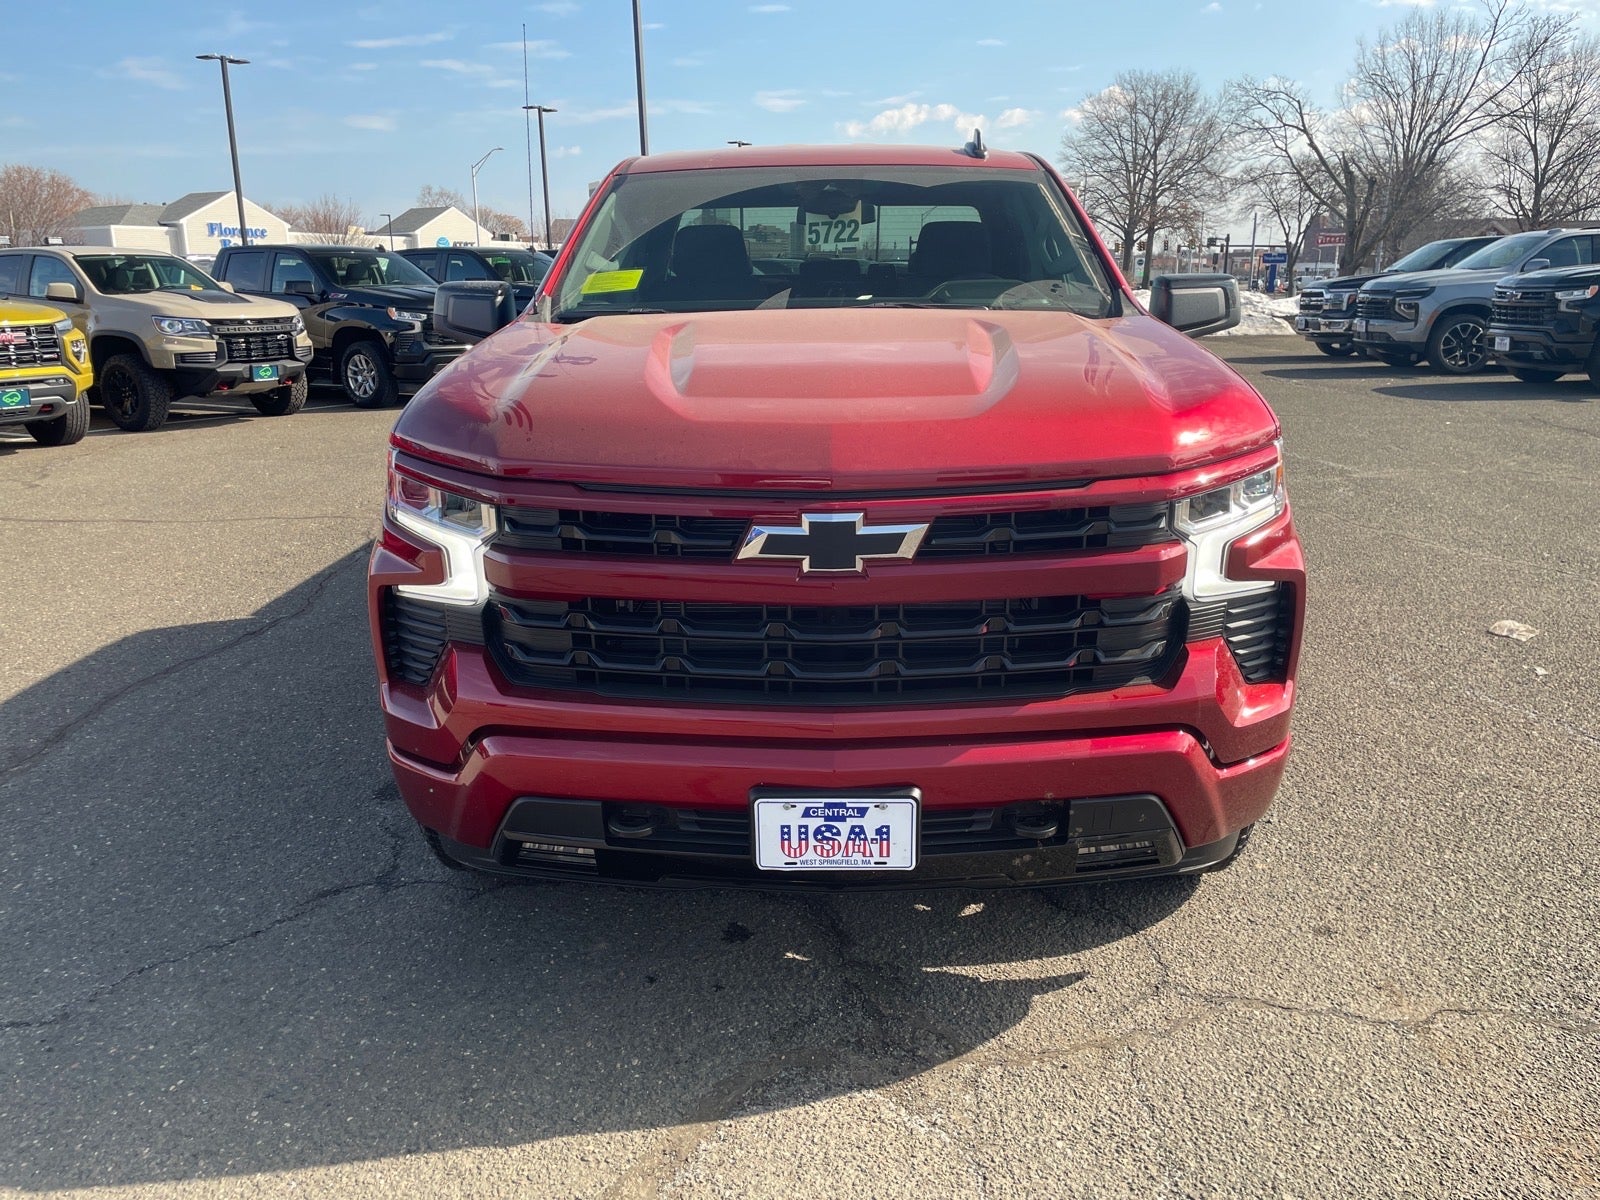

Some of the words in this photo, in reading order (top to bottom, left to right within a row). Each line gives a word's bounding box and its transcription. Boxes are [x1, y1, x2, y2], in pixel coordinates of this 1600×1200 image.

[807, 219, 860, 245] 5722
[216, 324, 295, 332] CHEVROLET
[809, 808, 861, 817] CENTRAL
